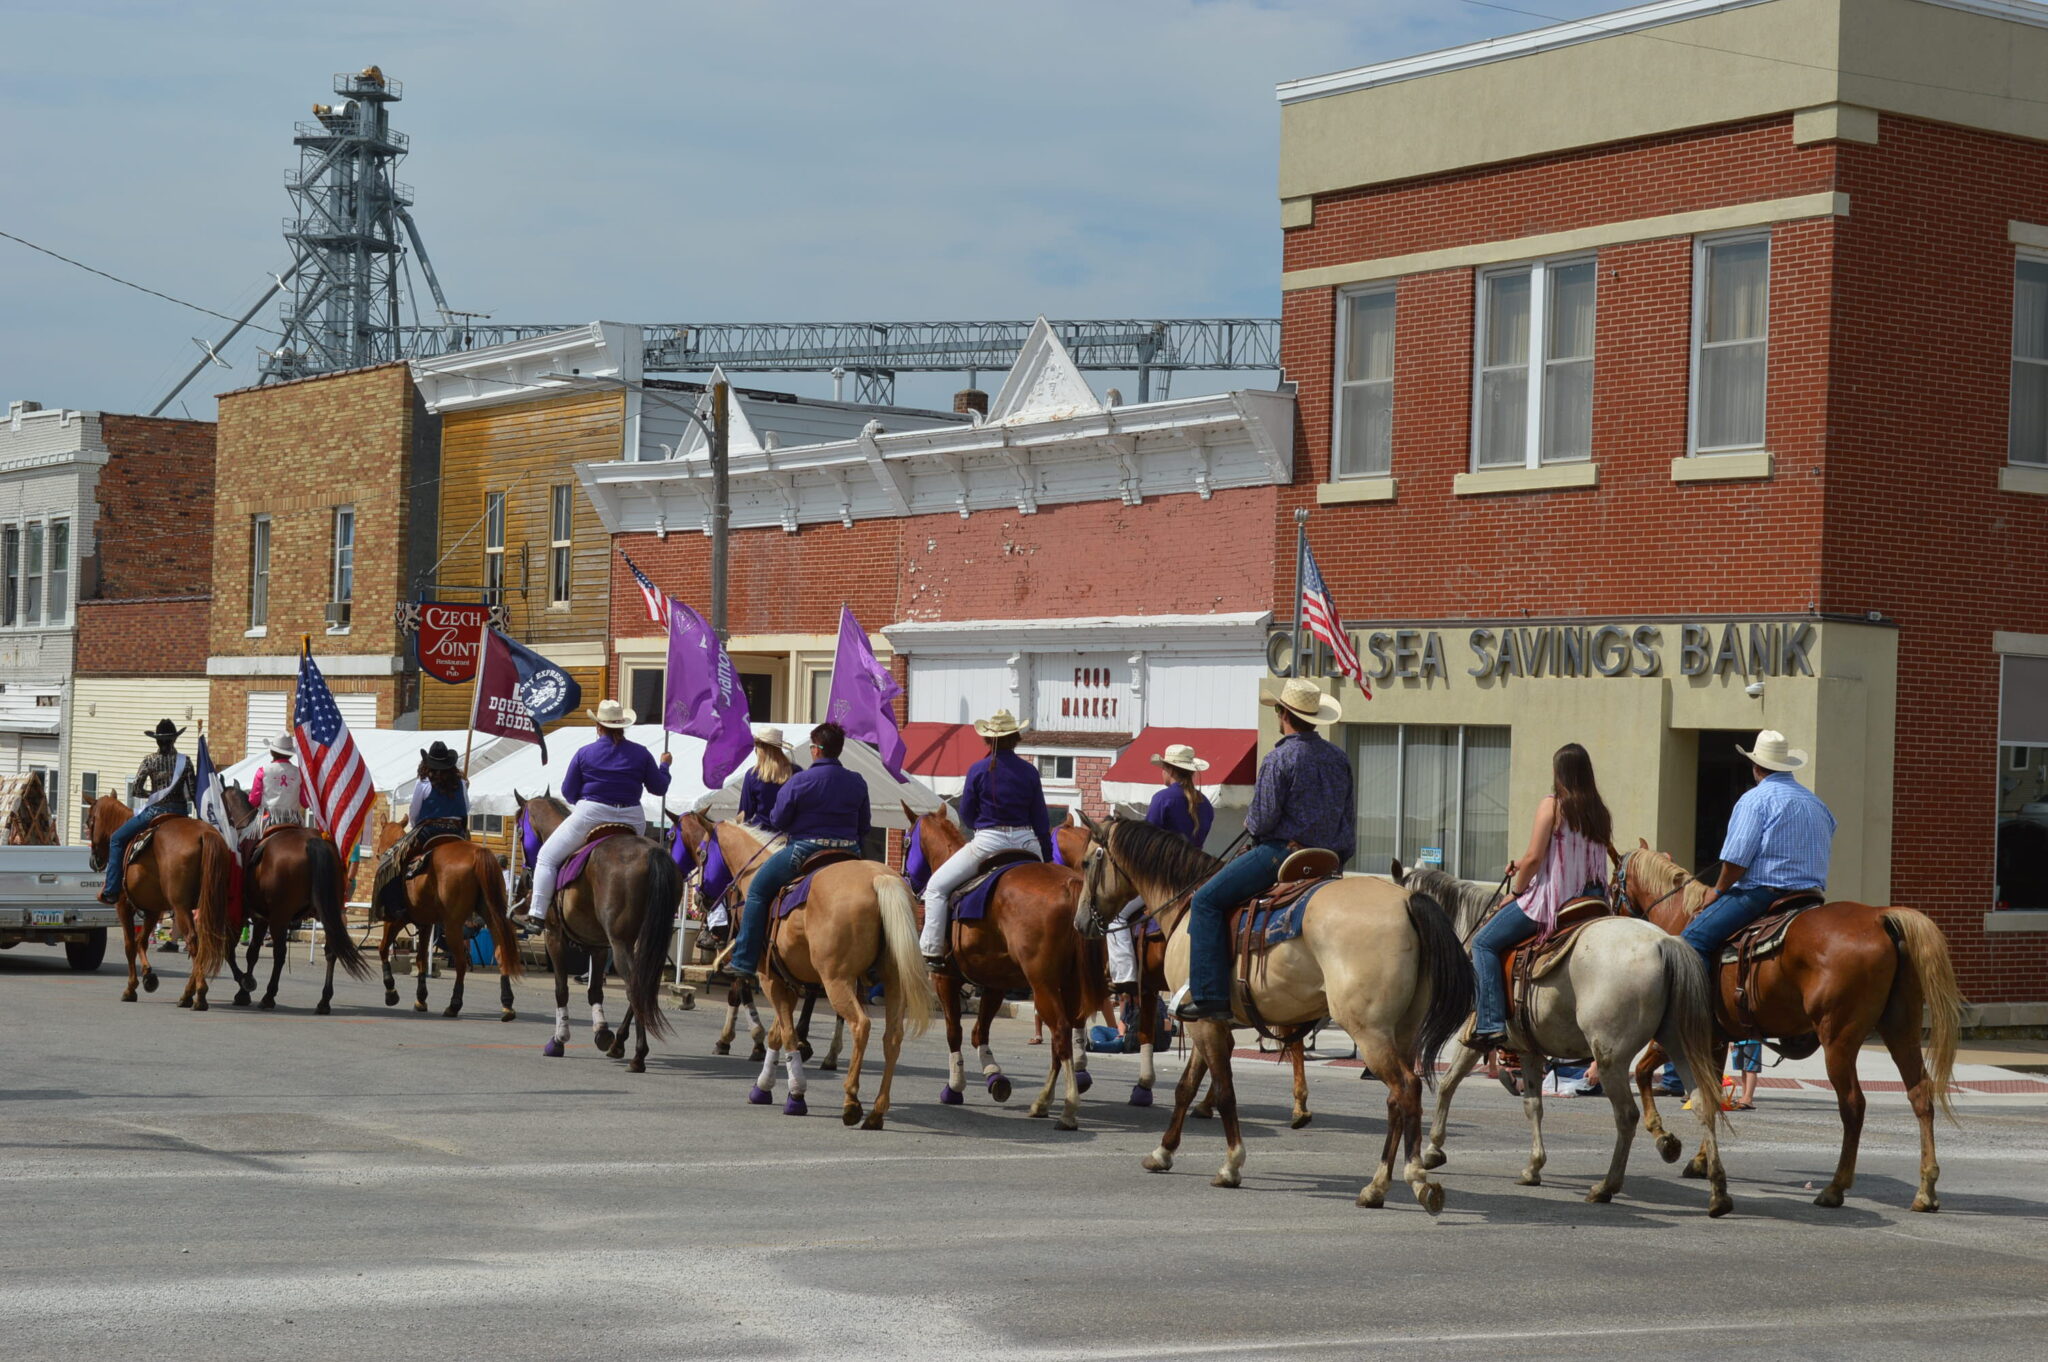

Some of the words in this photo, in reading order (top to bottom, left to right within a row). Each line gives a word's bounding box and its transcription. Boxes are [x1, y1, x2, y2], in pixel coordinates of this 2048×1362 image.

[426, 607, 481, 630] CZECH
[425, 627, 480, 657] POINT
[1267, 631, 1446, 678] CHESEA
[1467, 625, 1657, 677] SAVINGS
[1680, 623, 1815, 677] BANK
[435, 658, 470, 666] Restaurant
[520, 676, 535, 693] ONY
[535, 669, 566, 687] EXPRESS
[1075, 667, 1111, 688] FOOD
[488, 696, 528, 716] DOUB
[1062, 697, 1118, 718] MARKET
